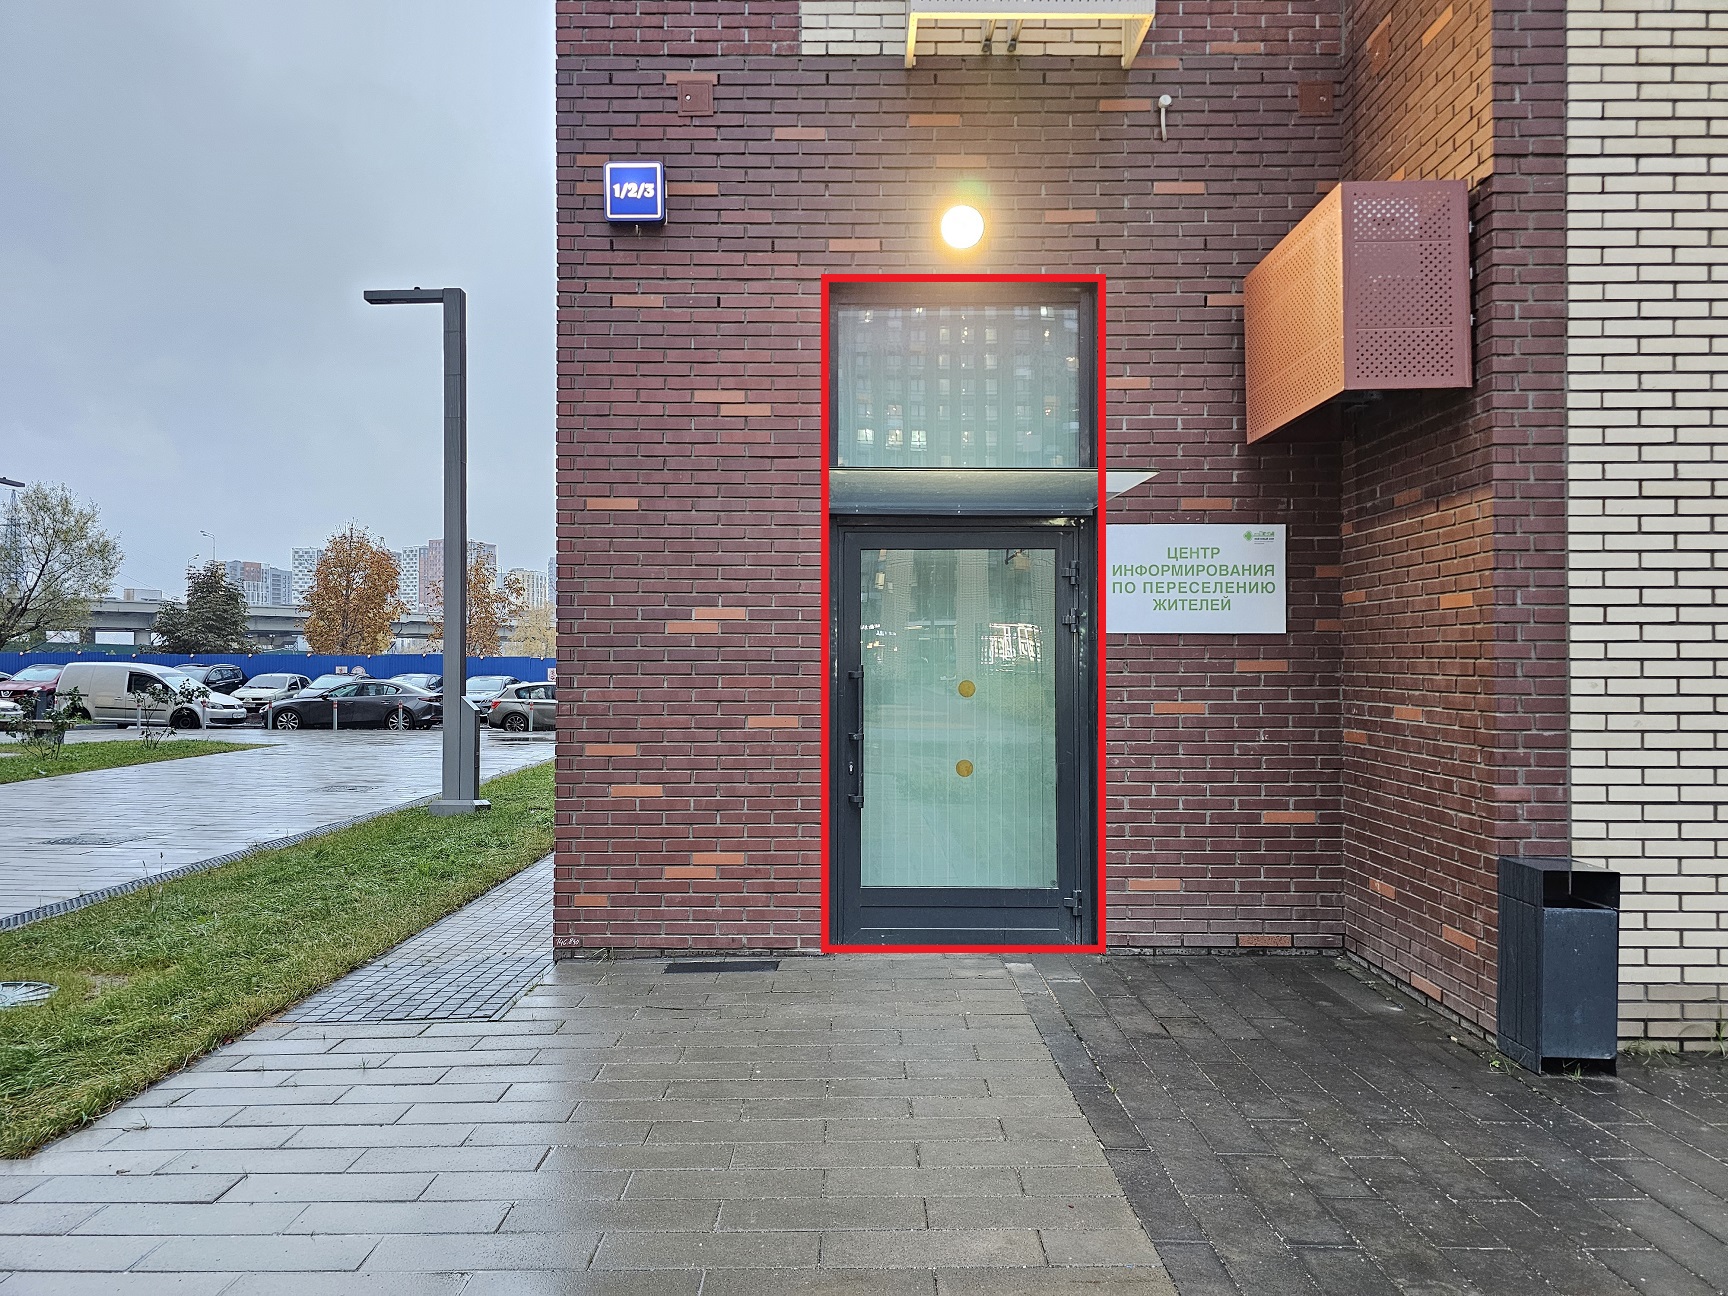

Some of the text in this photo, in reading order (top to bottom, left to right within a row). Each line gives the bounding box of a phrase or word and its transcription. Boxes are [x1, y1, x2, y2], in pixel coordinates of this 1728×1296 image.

[612, 182, 655, 200] 1/2/3
[1167, 547, 1221, 561] ЦЕНТР
[1112, 564, 1275, 577] ИНФОРМИРОВАНИЯ
[1112, 581, 1276, 594] ПО ПЕРЕСЕЛЕНИЮ
[1153, 596, 1231, 611] ЖИТЕЛЕЙ
